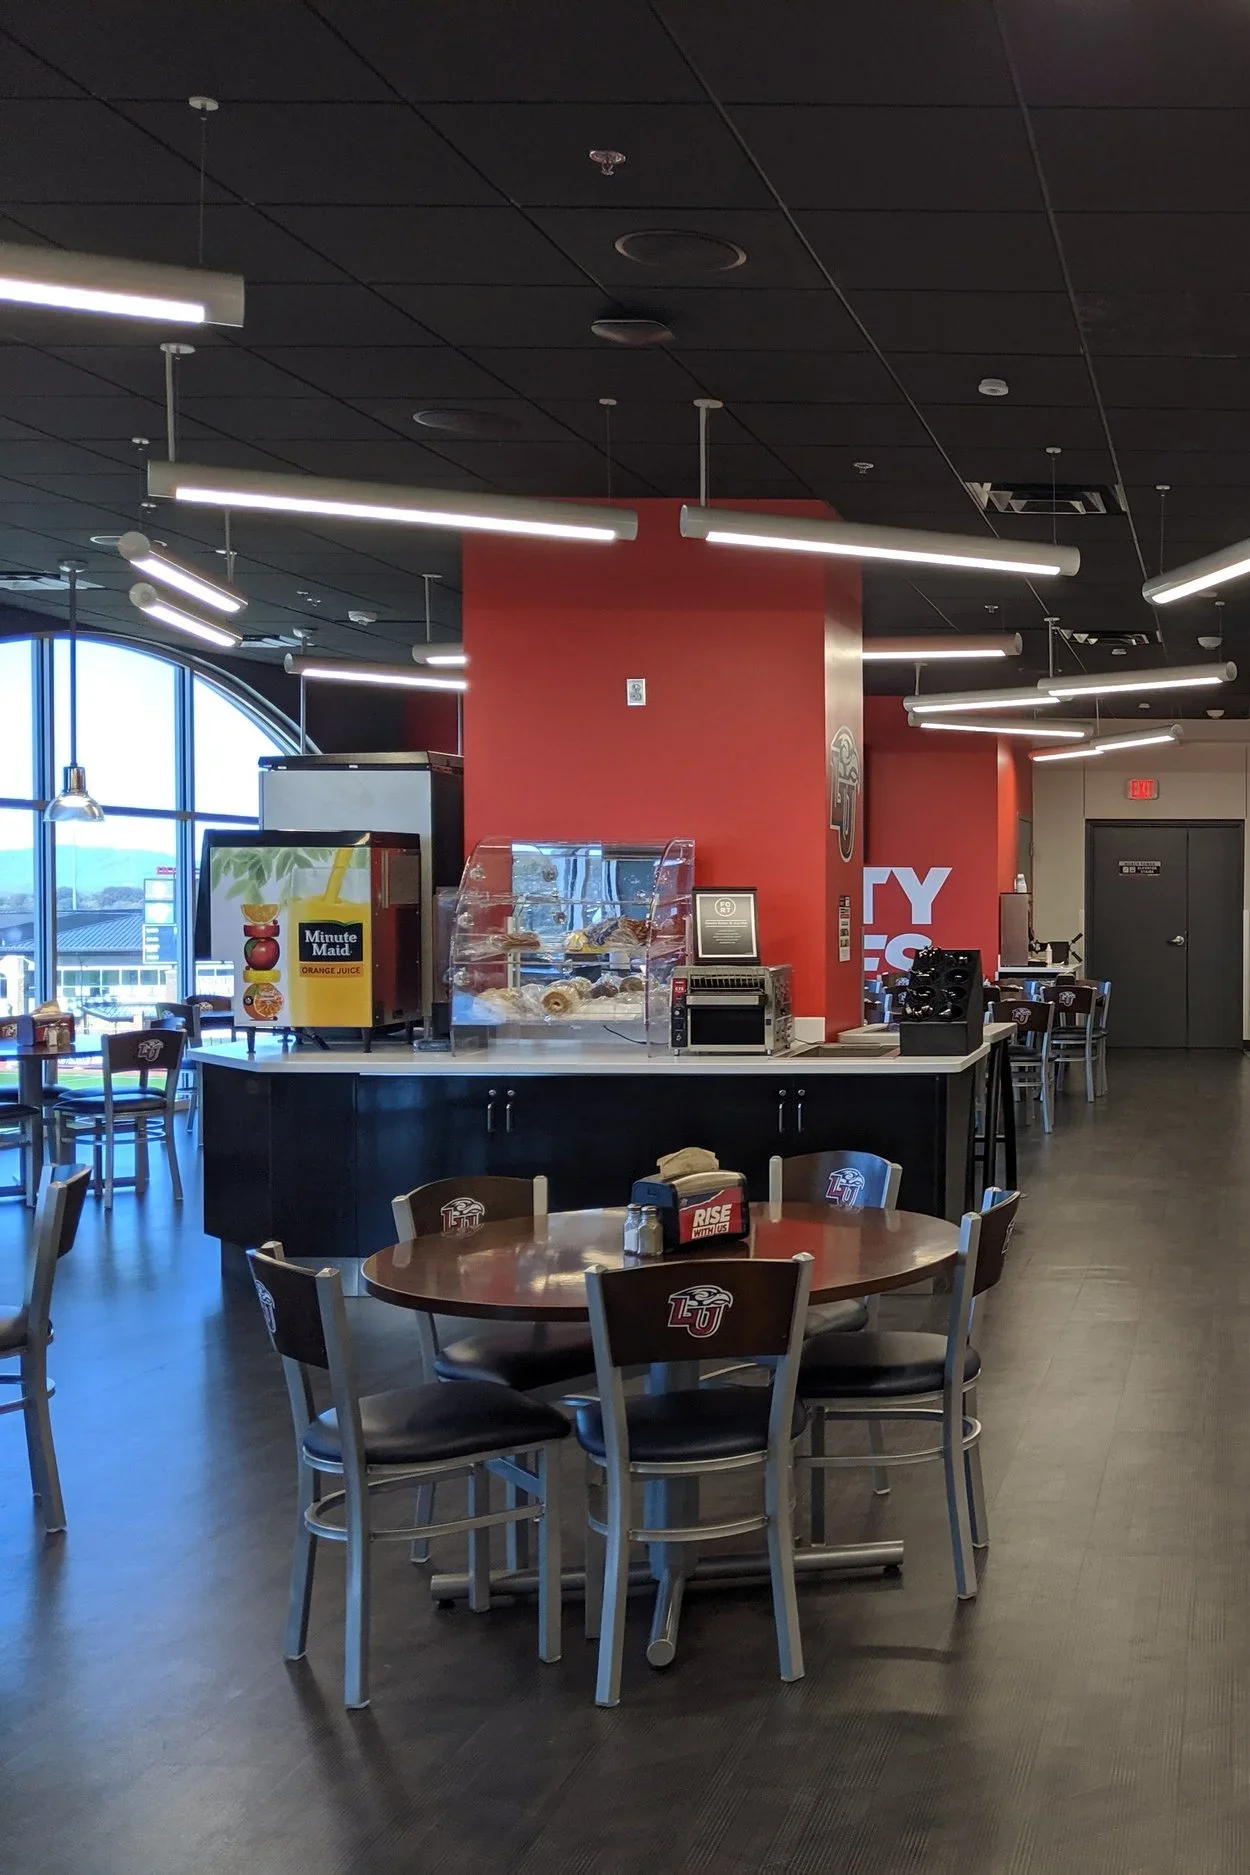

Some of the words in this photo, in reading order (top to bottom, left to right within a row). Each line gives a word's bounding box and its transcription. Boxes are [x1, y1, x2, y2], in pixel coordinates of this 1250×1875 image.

[1131, 780, 1154, 799] EXIT
[305, 930, 357, 943] Minute
[312, 943, 351, 956] Maid
[693, 1204, 732, 1227] RISE
[693, 1226, 714, 1238] WITH
[717, 1224, 728, 1234] US
